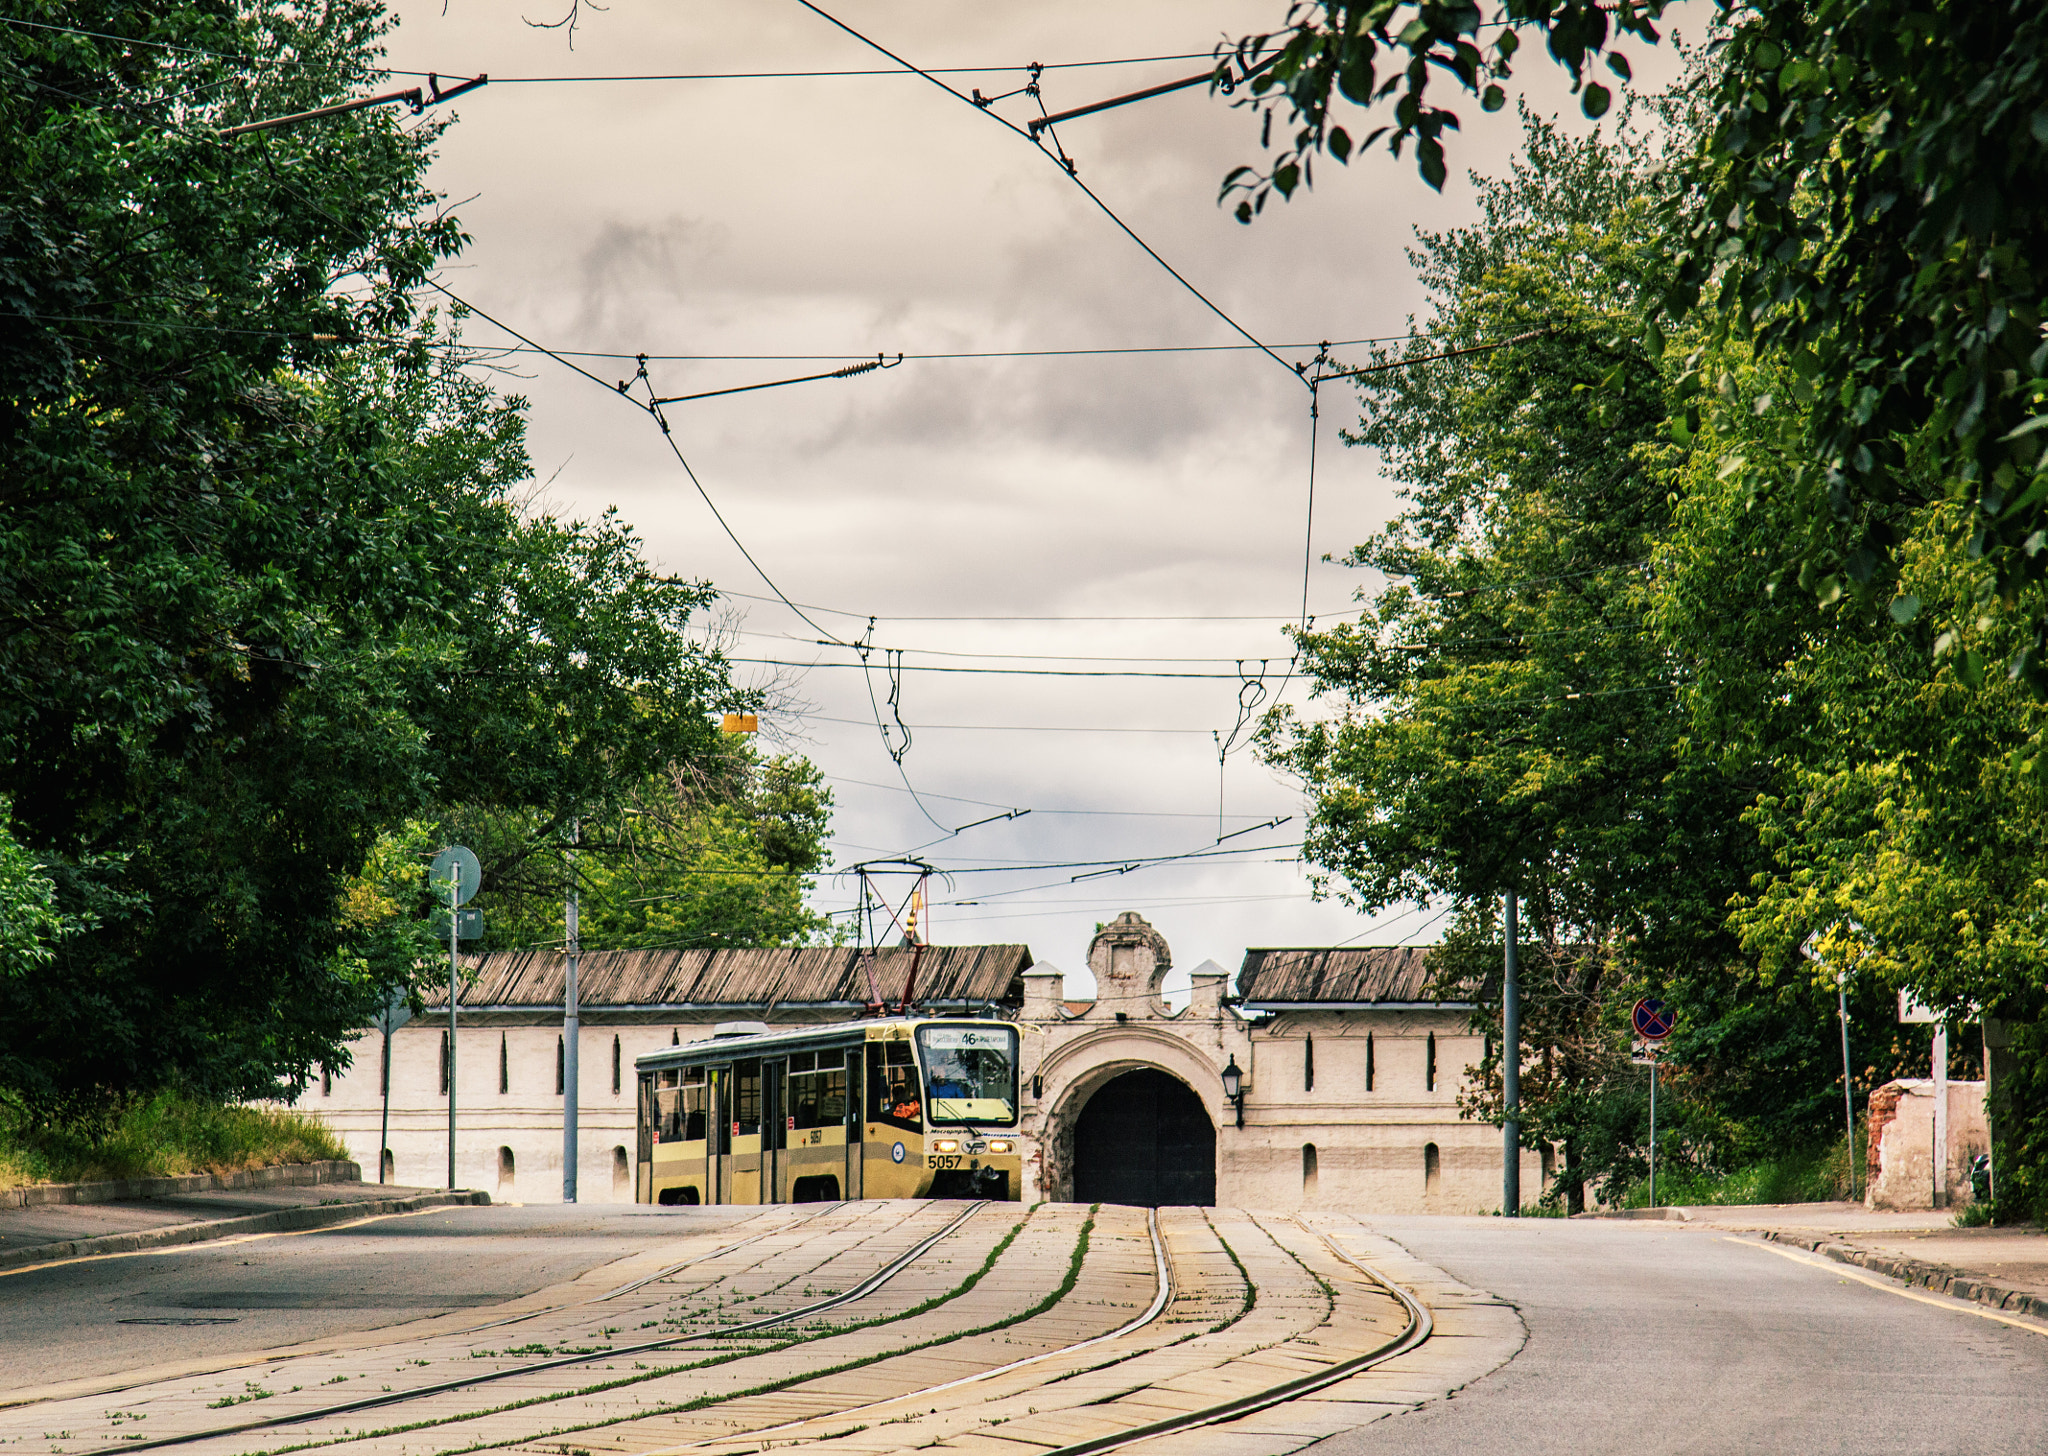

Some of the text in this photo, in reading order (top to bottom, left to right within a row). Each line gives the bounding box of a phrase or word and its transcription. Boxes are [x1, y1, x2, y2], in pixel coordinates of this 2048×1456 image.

[961, 1033, 976, 1045] 46
[810, 1130, 821, 1144] 5057
[928, 1155, 962, 1169] 5057
